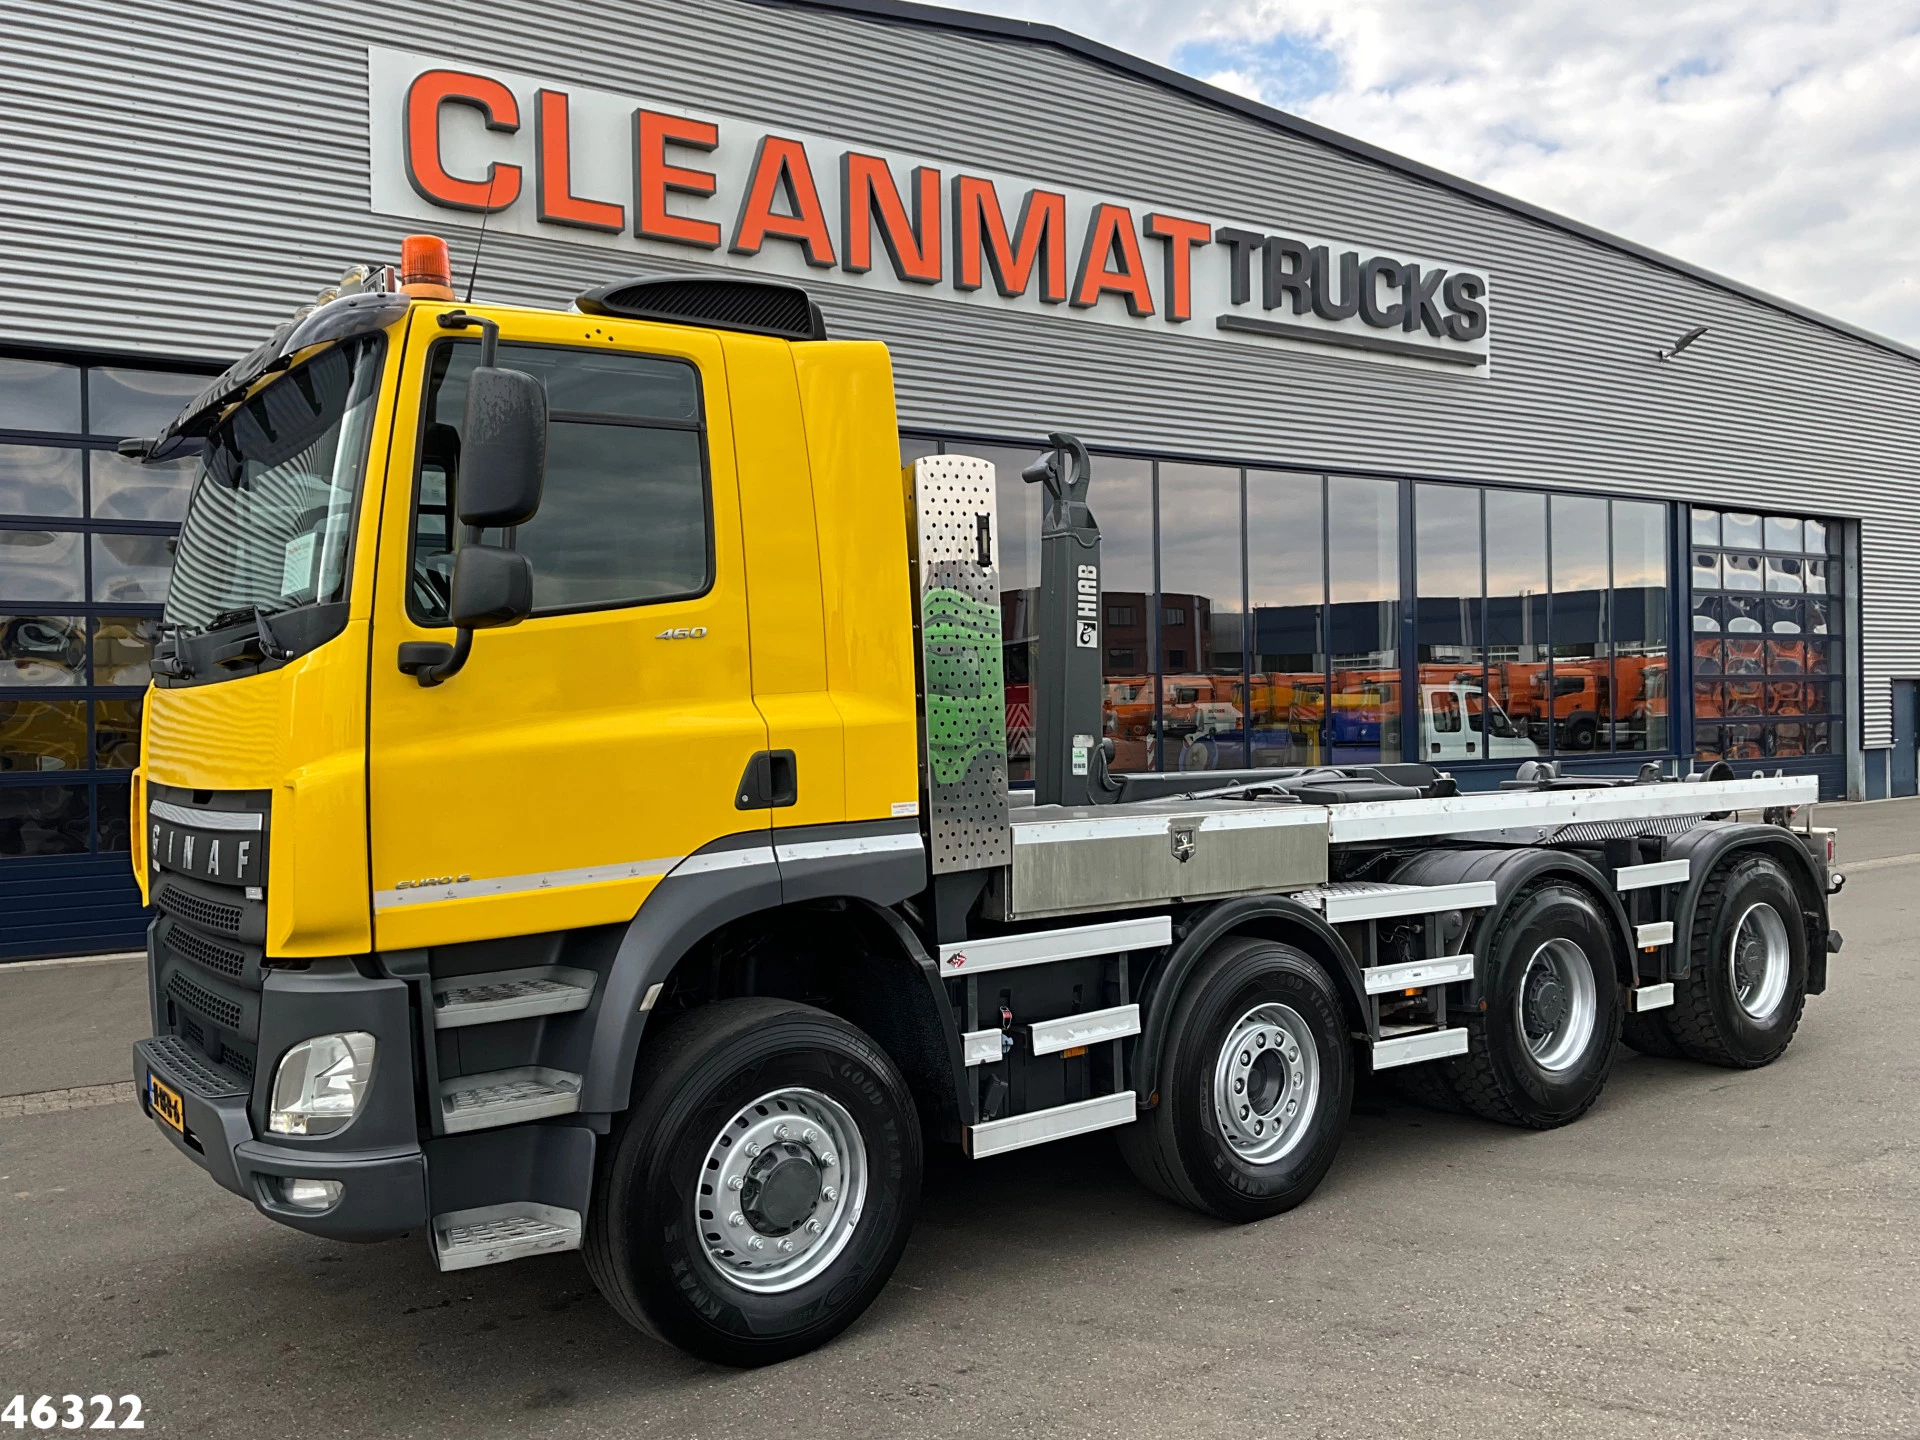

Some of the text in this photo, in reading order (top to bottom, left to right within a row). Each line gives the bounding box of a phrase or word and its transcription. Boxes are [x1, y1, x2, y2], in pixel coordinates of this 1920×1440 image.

[402, 69, 1487, 341] CLEANMAT TRUCKS
[1077, 564, 1097, 617] HIAB
[655, 626, 708, 640] 460
[152, 824, 251, 879] GINAF
[395, 873, 471, 890] EURO 6
